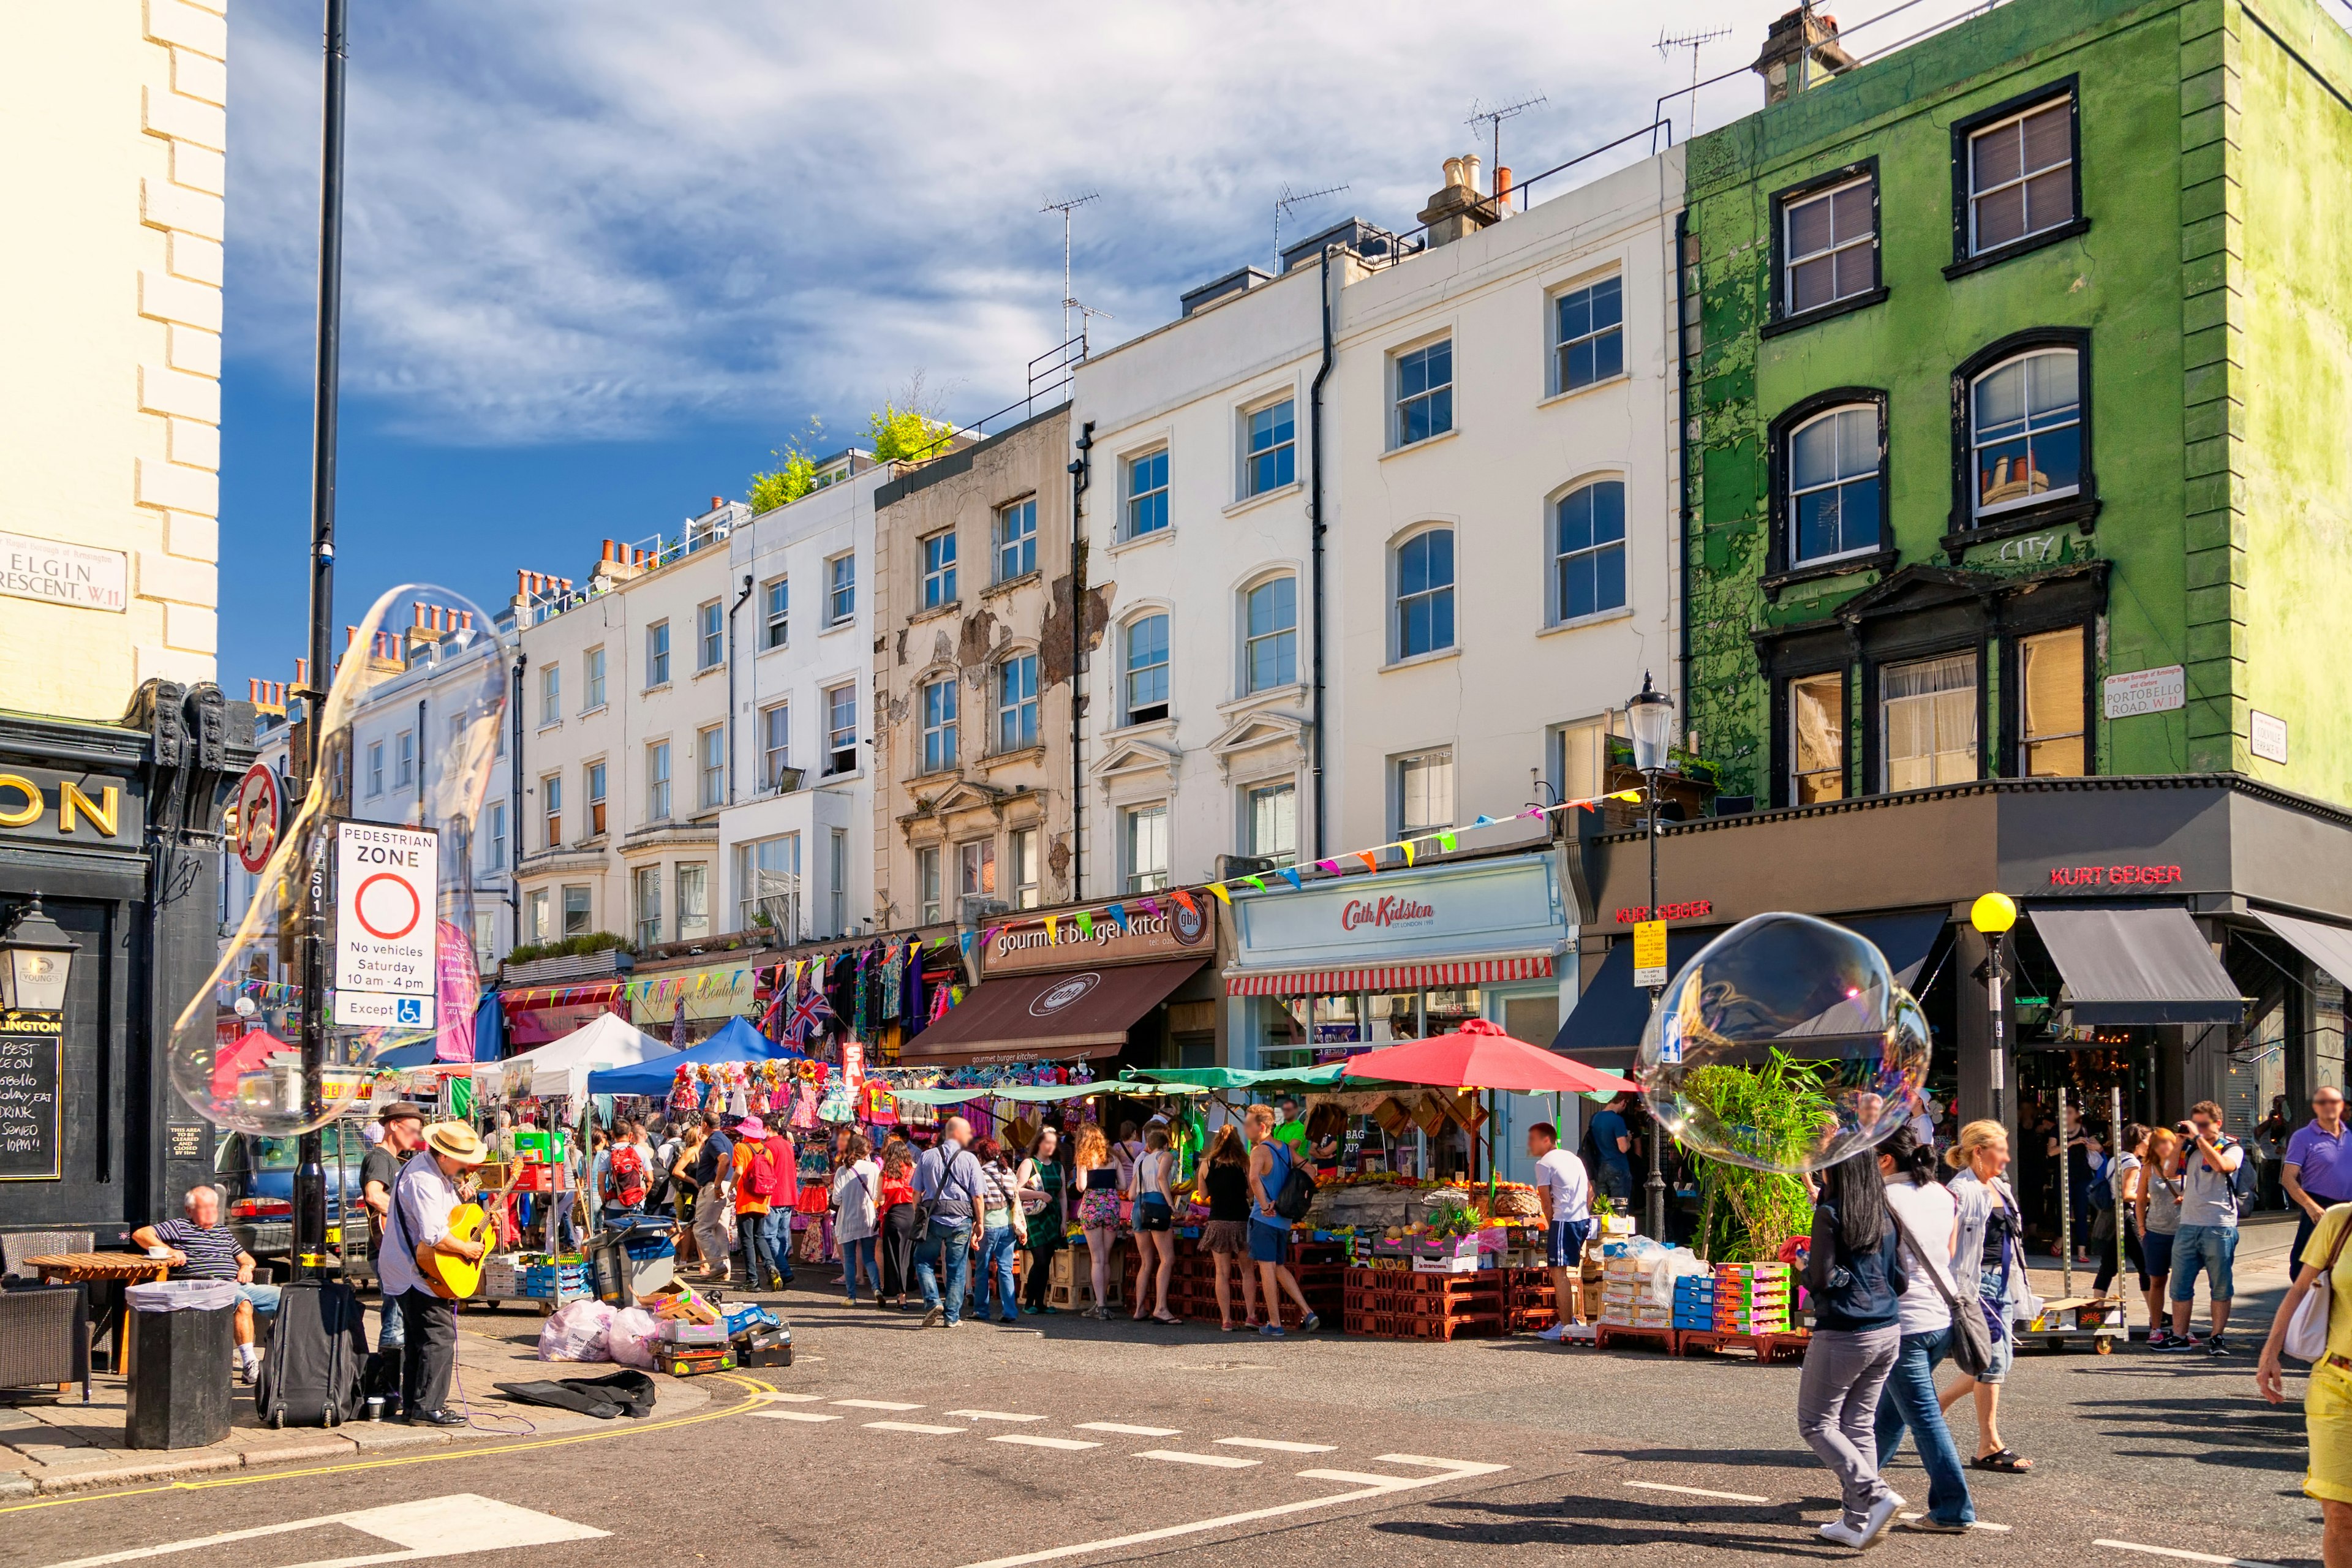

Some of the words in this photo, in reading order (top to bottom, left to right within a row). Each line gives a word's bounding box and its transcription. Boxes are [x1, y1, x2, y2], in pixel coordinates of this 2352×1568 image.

[74, 549, 112, 564] Kensington
[2000, 536, 2054, 562] CITY
[11, 553, 90, 582] ELGIN
[2157, 668, 2181, 676] Kensington
[2107, 684, 2182, 704] PORTOBELLO
[2153, 696, 2178, 708] W.11
[345, 829, 432, 848] PEDESTRIAN
[357, 845, 419, 868] ZONE
[2051, 867, 2105, 885] KURT
[2108, 865, 2182, 884] GEIGER
[1342, 900, 1375, 930] Cath
[1375, 895, 1434, 927] Kidston
[1657, 900, 1711, 920] GEIGER
[1181, 912, 1199, 927] gbk
[998, 926, 1065, 957] gourmet
[1129, 910, 1171, 937] kitch
[351, 941, 368, 952] No
[373, 943, 423, 957] vehicles
[1149, 937, 1159, 946] tel:
[358, 959, 415, 975] Saturday
[23, 973, 59, 982] YOUNG'S
[347, 974, 361, 985] 10
[366, 976, 383, 986] am
[394, 976, 402, 988] 4
[405, 979, 423, 990] pm
[697, 976, 746, 1006] Boutique
[350, 1003, 394, 1016] Except
[1446, 1005, 1461, 1016] 158
[14, 1058, 33, 1069] ON
[972, 1055, 996, 1065] gourmet
[997, 1054, 1016, 1063] burger
[1016, 1052, 1038, 1061] kitchen
[34, 1093, 52, 1102] EAT
[322, 1084, 373, 1097] GERMAN
[1346, 1130, 1365, 1139] BAG
[571, 1333, 586, 1344] Street
